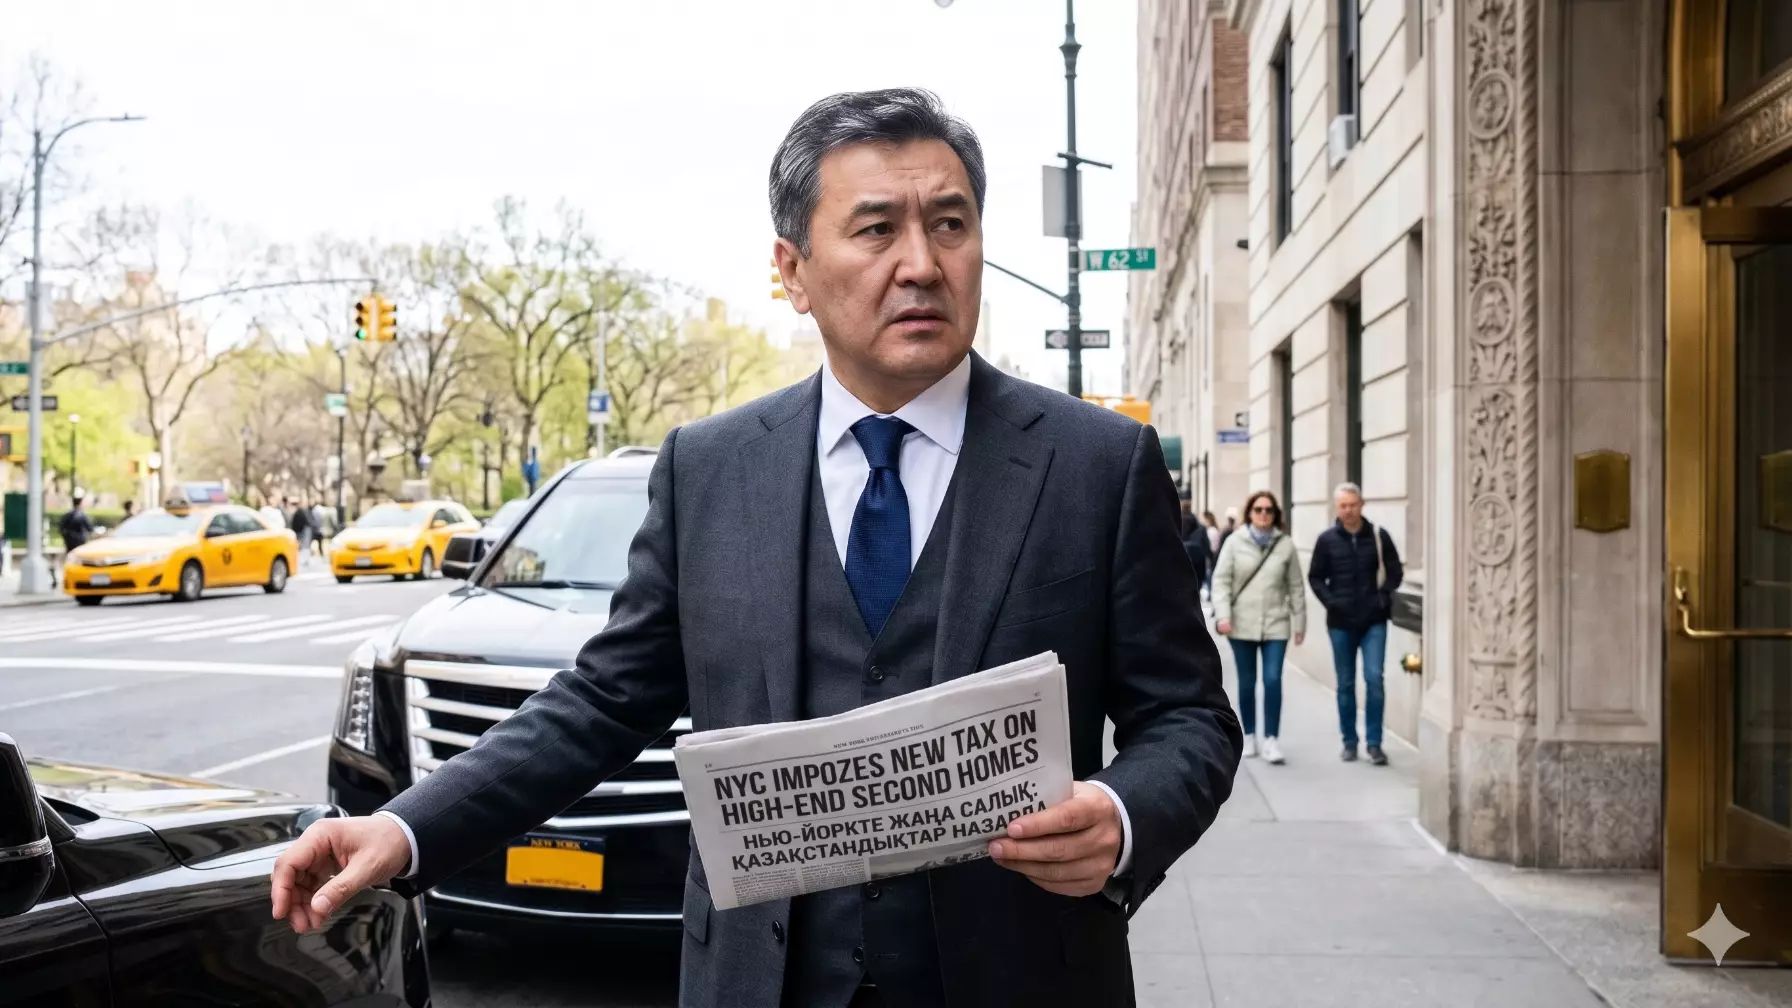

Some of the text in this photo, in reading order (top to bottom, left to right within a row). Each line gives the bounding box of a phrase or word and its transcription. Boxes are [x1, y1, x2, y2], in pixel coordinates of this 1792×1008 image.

[1089, 251, 1104, 270] W
[1108, 250, 1131, 270] 62
[714, 771, 767, 801] NYC
[772, 752, 885, 792] IMPOZES
[890, 735, 945, 775] NEW
[951, 719, 998, 756] TAX
[1004, 709, 1037, 739] ON
[721, 737, 1039, 826] HIGH-END SECOND HOMES
[732, 826, 947, 873] ҚАЗАҚСТАНДЫҚТАР
[743, 780, 1039, 850] НЬЮ-ЙОРКТЕ ЖАҢА САЛЫҚ:
